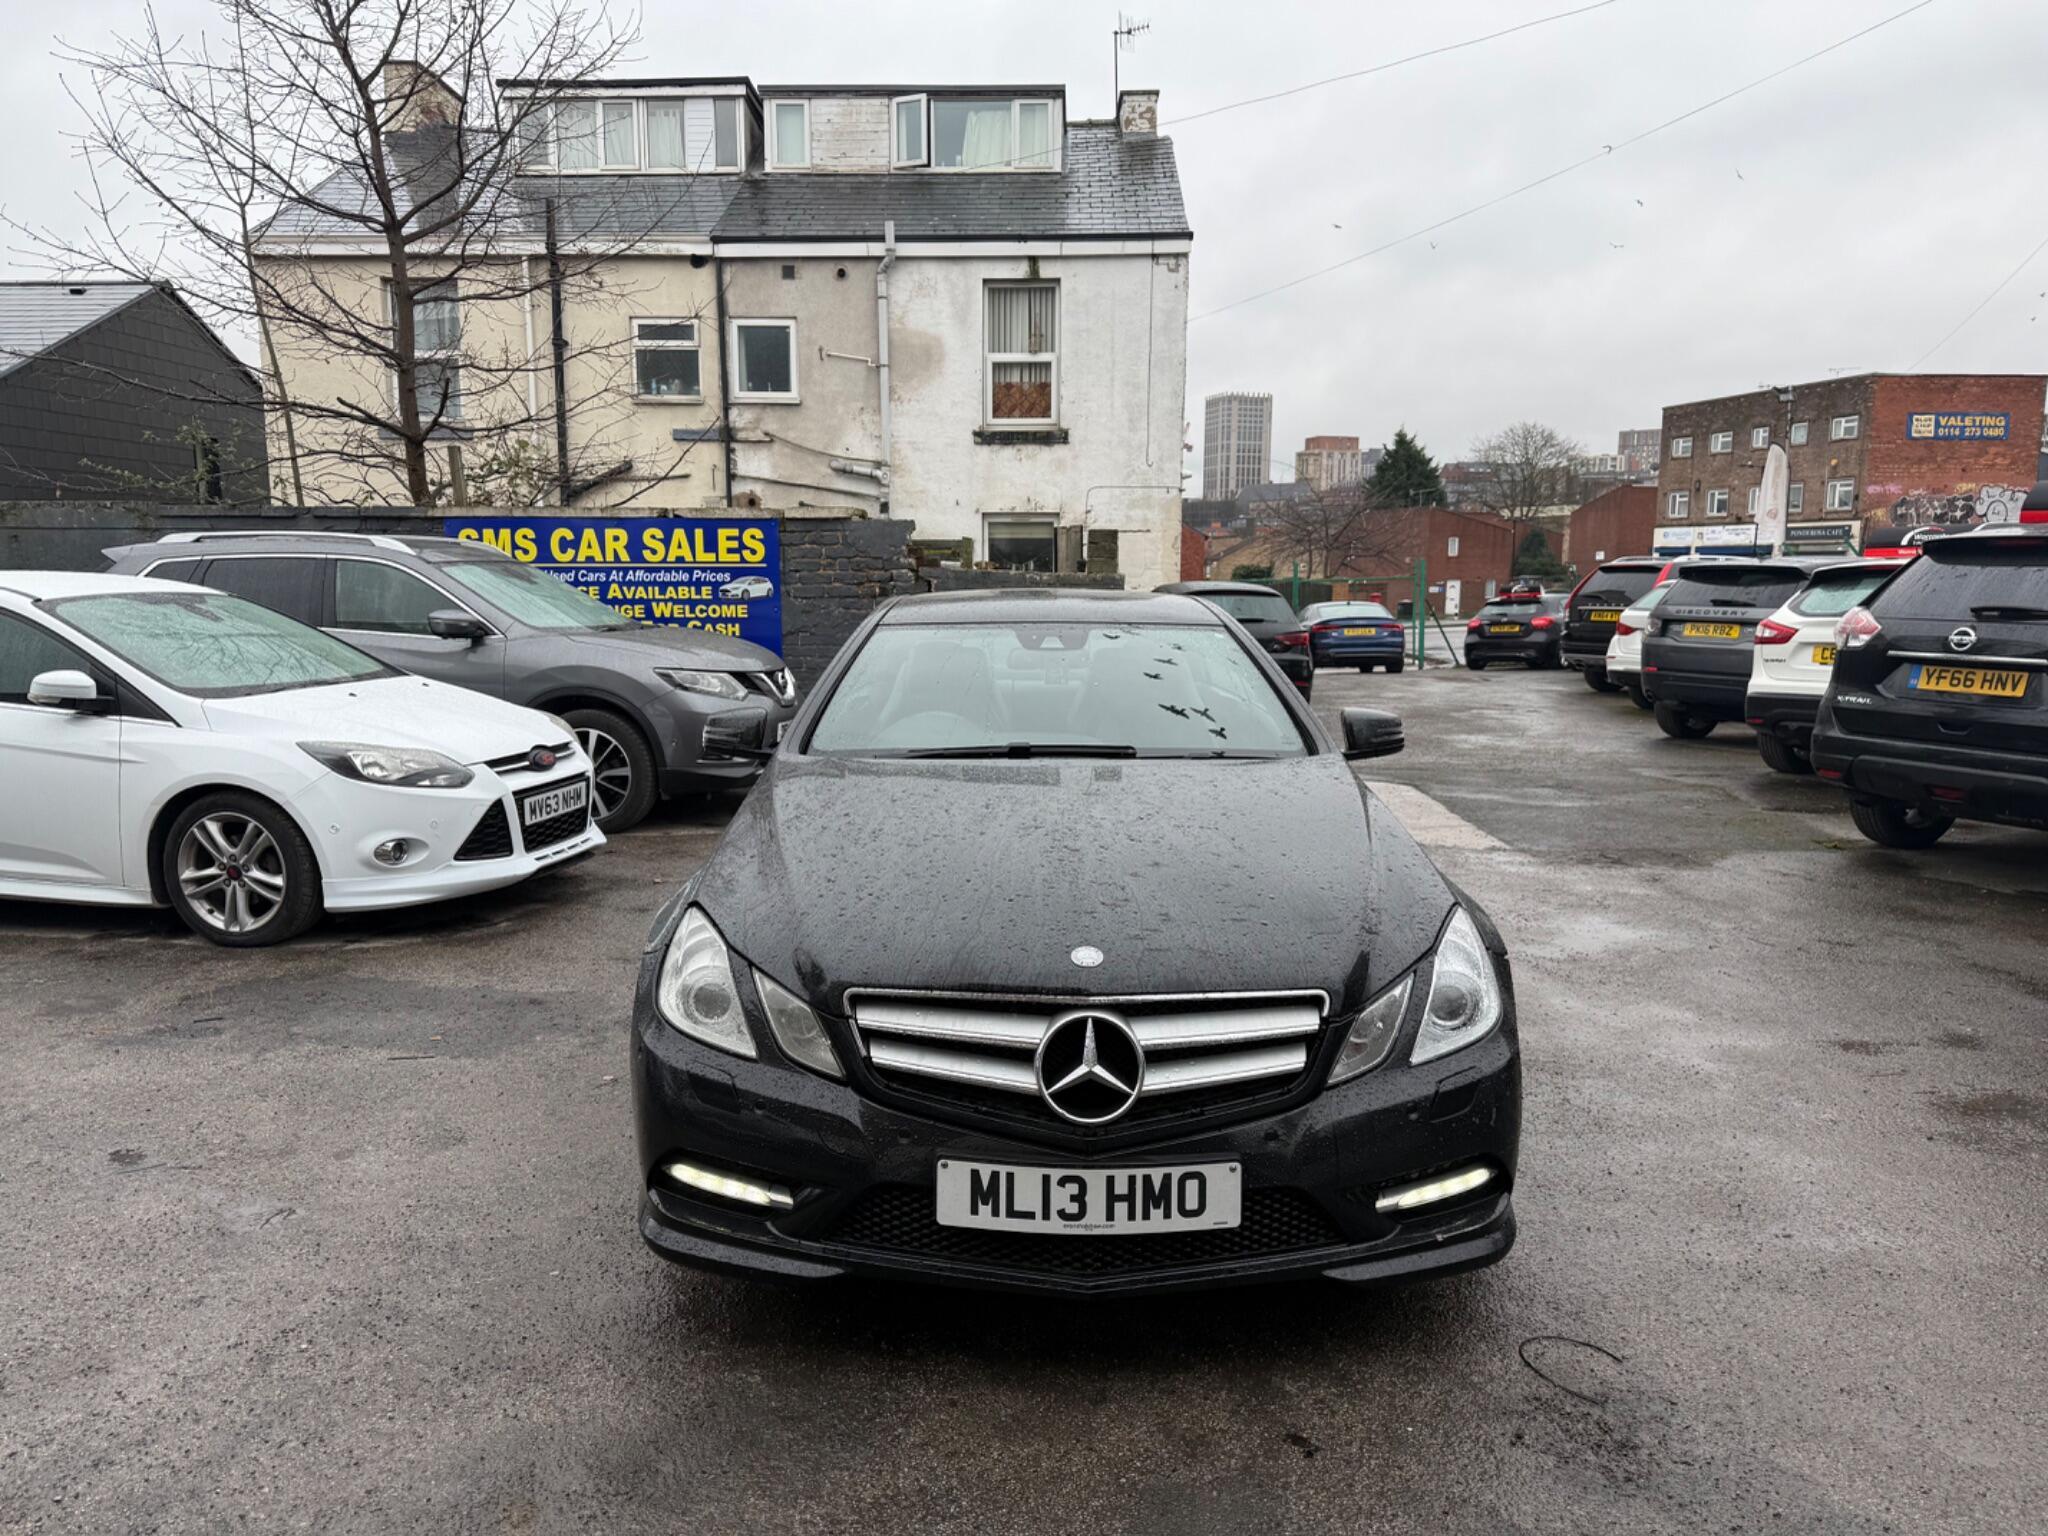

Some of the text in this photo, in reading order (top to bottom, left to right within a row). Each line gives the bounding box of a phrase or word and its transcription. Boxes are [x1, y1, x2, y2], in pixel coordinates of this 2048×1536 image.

[1938, 415, 2005, 427] VALETING
[1964, 428, 1981, 437] 273
[550, 527, 630, 563] CAR
[642, 527, 766, 563] SALES
[578, 569, 607, 582] Cars
[609, 569, 624, 582] At
[625, 569, 690, 582] Affordable
[692, 570, 731, 582] Prices
[1925, 666, 2023, 692] YF66 HNV
[528, 785, 582, 821] MV63 NHM
[970, 1168, 1207, 1222] ML13 HMO
